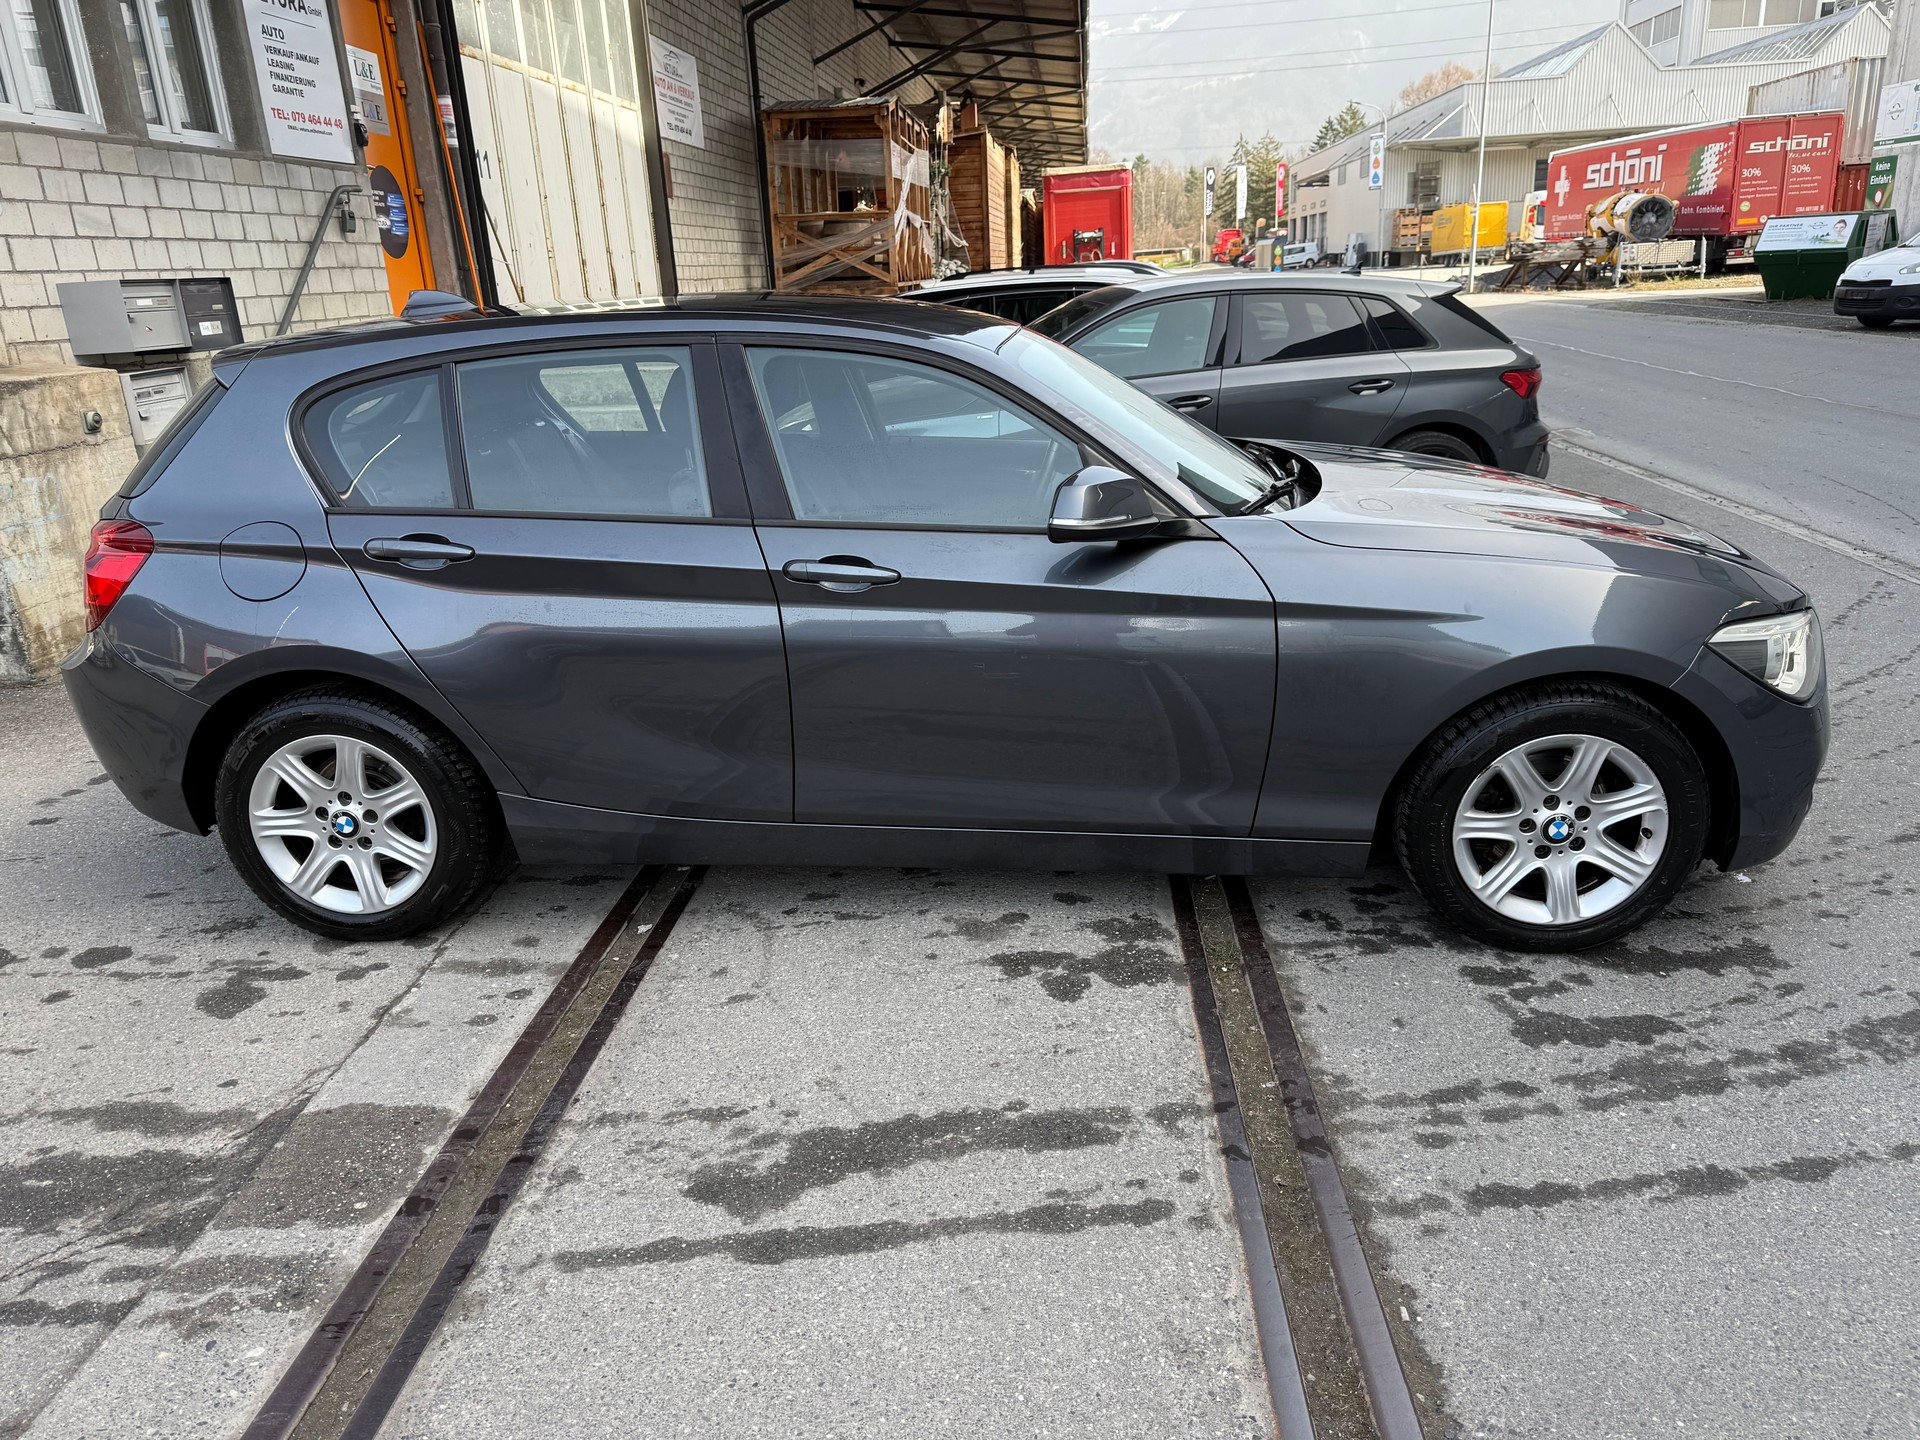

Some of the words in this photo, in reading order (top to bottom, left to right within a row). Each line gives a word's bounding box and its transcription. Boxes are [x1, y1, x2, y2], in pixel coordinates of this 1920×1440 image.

[307, 6, 322, 17] GmbH
[261, 24, 285, 40] AUTO
[266, 57, 295, 71] LEASING
[353, 59, 376, 80] L&E
[269, 71, 316, 88] FINANZIERUNG
[272, 84, 305, 98] GARANTIE
[361, 101, 382, 120] L&E
[271, 107, 290, 120] TEL:
[292, 110, 306, 123] 079
[308, 114, 322, 126] 464
[323, 116, 333, 128] 44
[334, 118, 344, 129] 48
[1582, 143, 1667, 190] schöni
[1741, 168, 1762, 177] 30%
[1790, 164, 1811, 174] 30%
[1875, 161, 1891, 172] keine
[1870, 174, 1892, 185] Einfahrt
